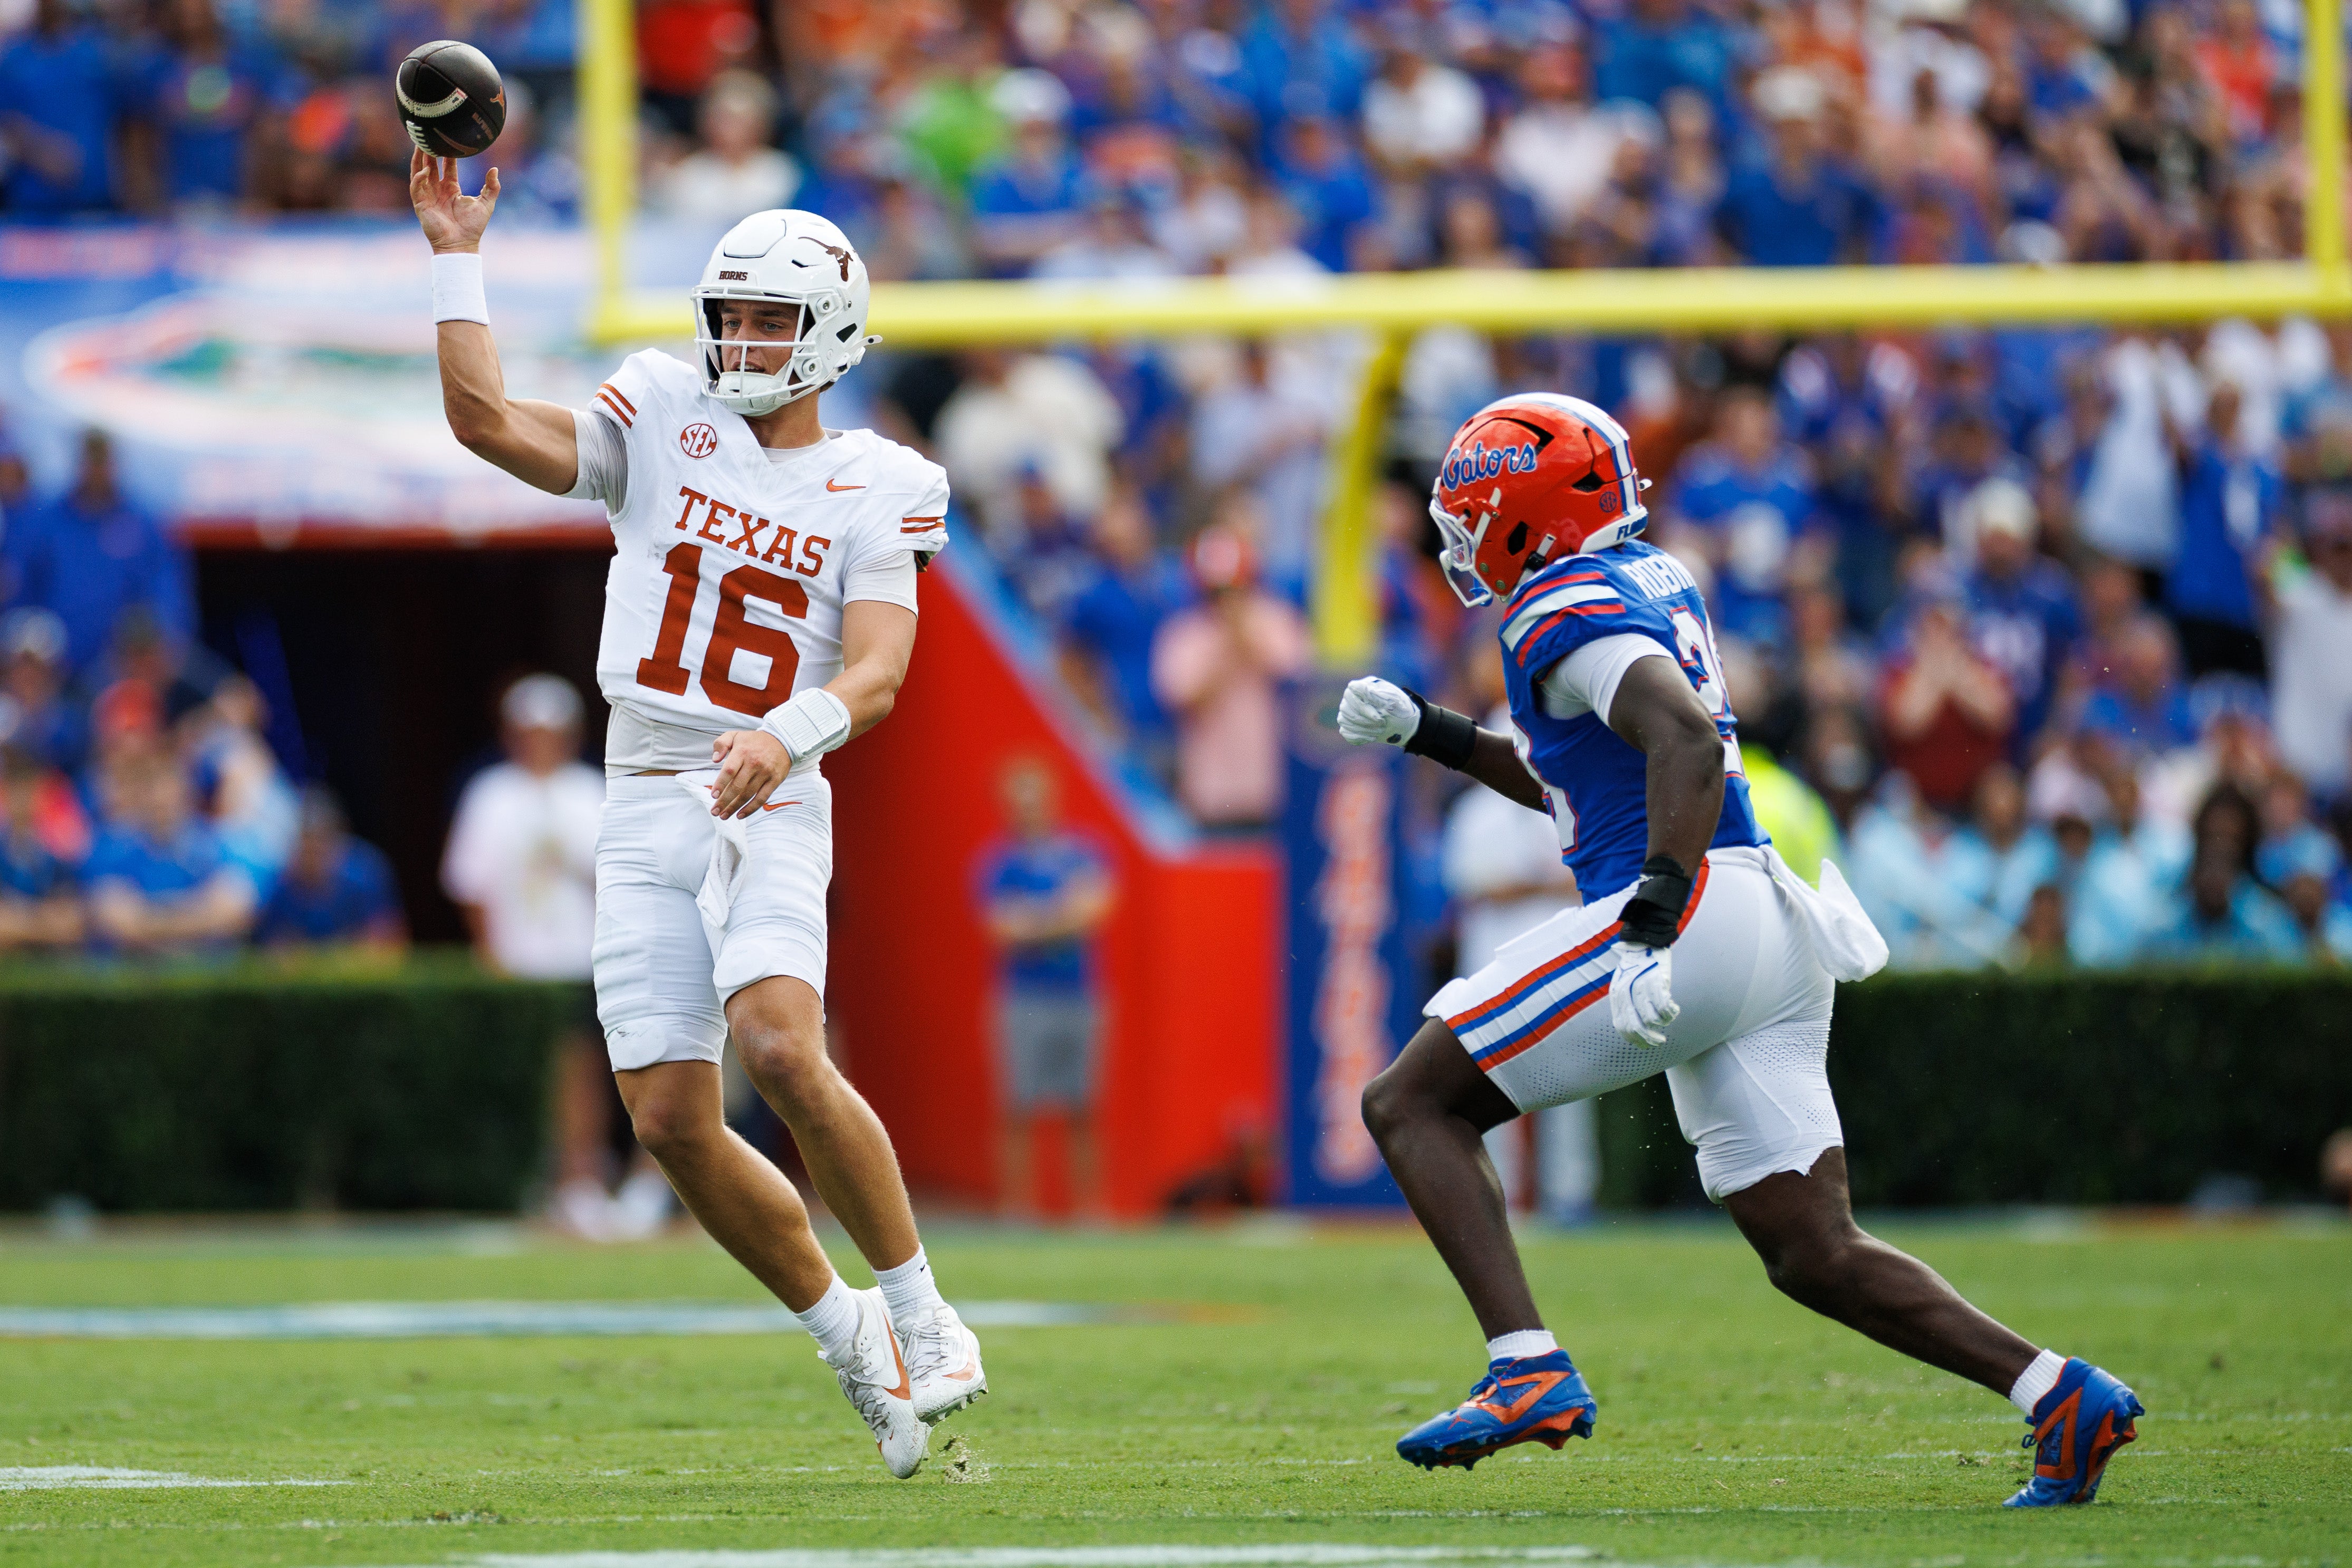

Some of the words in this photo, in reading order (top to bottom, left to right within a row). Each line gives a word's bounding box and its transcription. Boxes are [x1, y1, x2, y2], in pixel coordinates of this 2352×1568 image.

[718, 271, 748, 281] HORNS
[680, 424, 717, 458] SEC
[1443, 441, 1537, 492] Gators
[675, 486, 831, 578] TEXAS
[636, 542, 810, 718] 16
